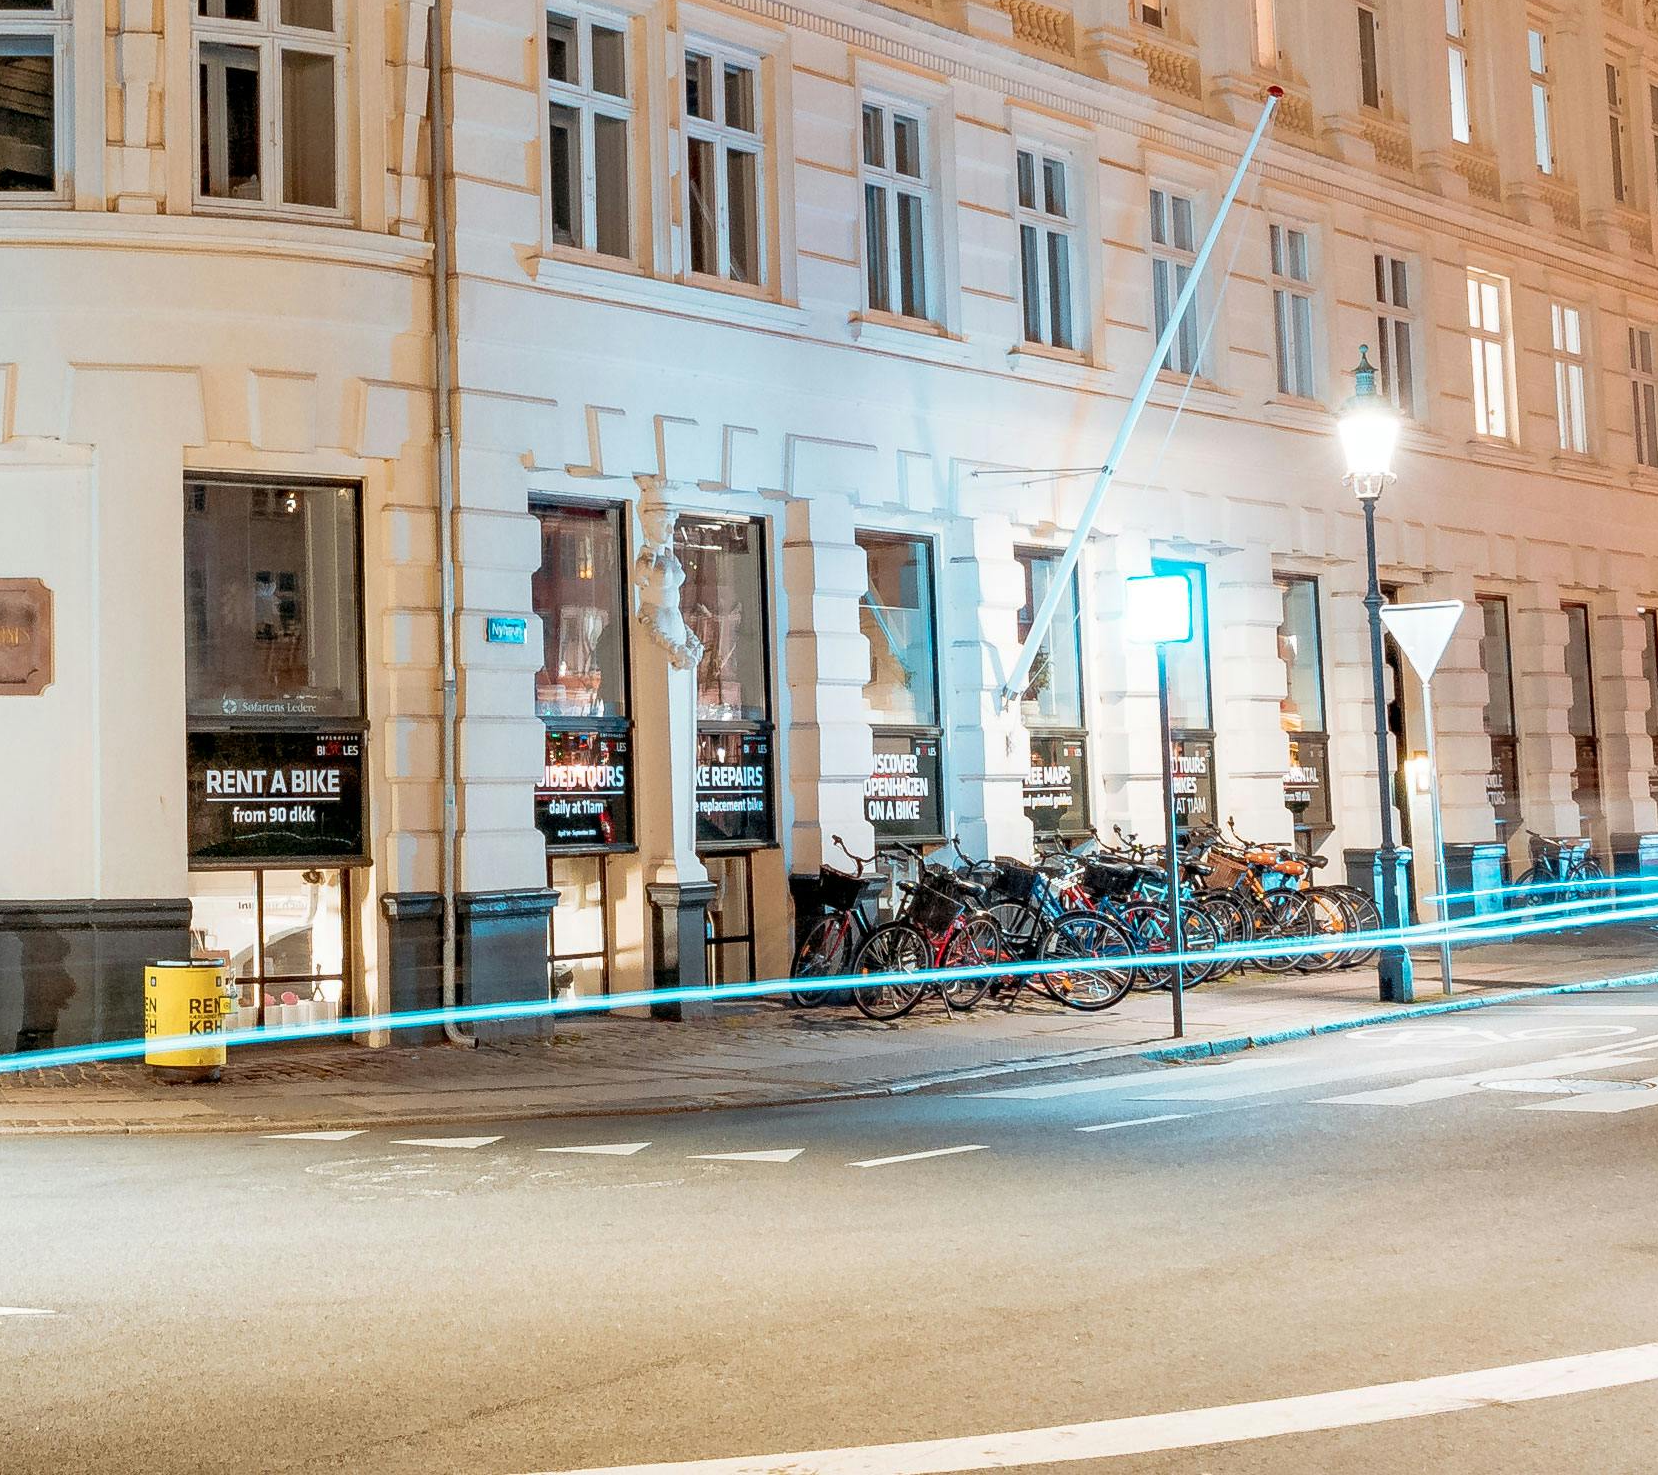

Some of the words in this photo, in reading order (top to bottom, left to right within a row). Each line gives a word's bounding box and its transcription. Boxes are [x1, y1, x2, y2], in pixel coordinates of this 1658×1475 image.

[242, 703, 284, 713] Søfartens
[287, 703, 316, 713] Ledere
[874, 754, 918, 773] ISCOVER
[206, 770, 266, 794] RENT
[270, 770, 287, 794] A
[291, 769, 340, 794] BIKE
[536, 765, 577, 787] UIDED
[577, 765, 624, 787] TOURS
[711, 766, 762, 786] REPAIRS
[1024, 766, 1044, 784] REE
[1044, 766, 1072, 784] MAPS
[864, 778, 928, 797] OPENHAGEN
[233, 807, 266, 823] from
[269, 807, 286, 823] 90
[289, 806, 315, 823] dkk
[549, 799, 571, 818] daily
[571, 800, 581, 814] at
[582, 800, 604, 814] 11am
[700, 798, 746, 815] replacement
[746, 797, 764, 811] bike
[868, 801, 884, 820] ON
[885, 801, 895, 820] A
[895, 801, 920, 820] BIKE
